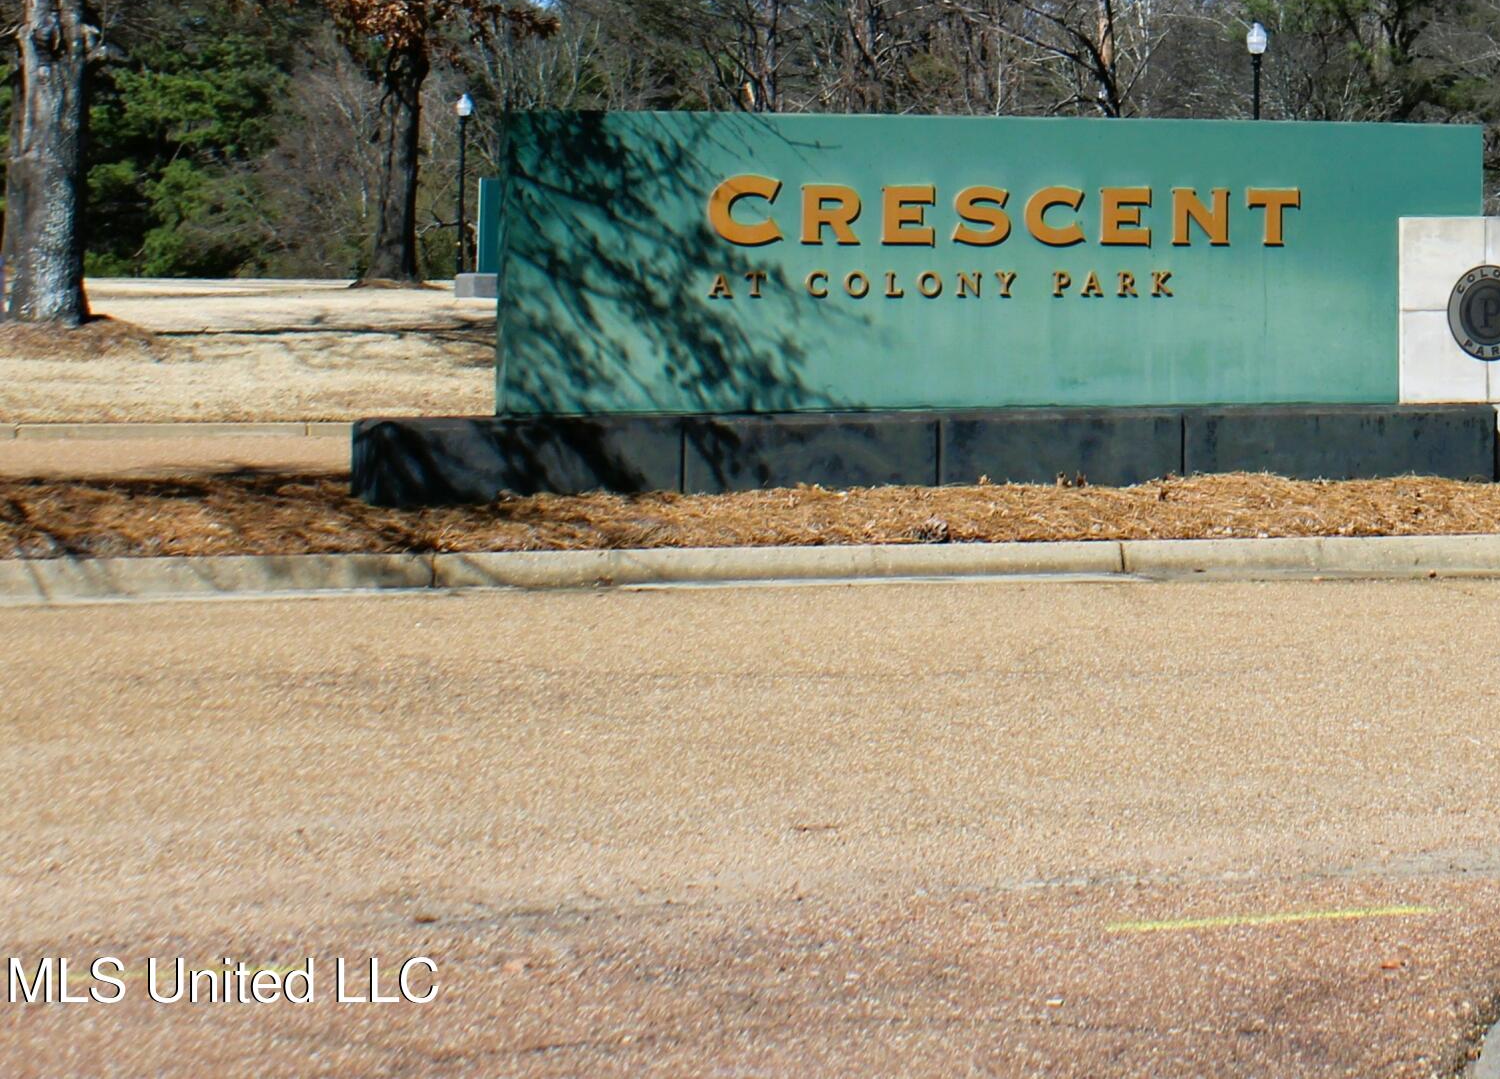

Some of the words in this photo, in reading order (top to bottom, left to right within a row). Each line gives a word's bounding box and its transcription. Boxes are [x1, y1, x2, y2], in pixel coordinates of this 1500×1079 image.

[706, 174, 1301, 248] CRESCENT
[708, 271, 768, 299] AT
[805, 270, 1018, 299] COLONY
[1053, 271, 1175, 299] PARK
